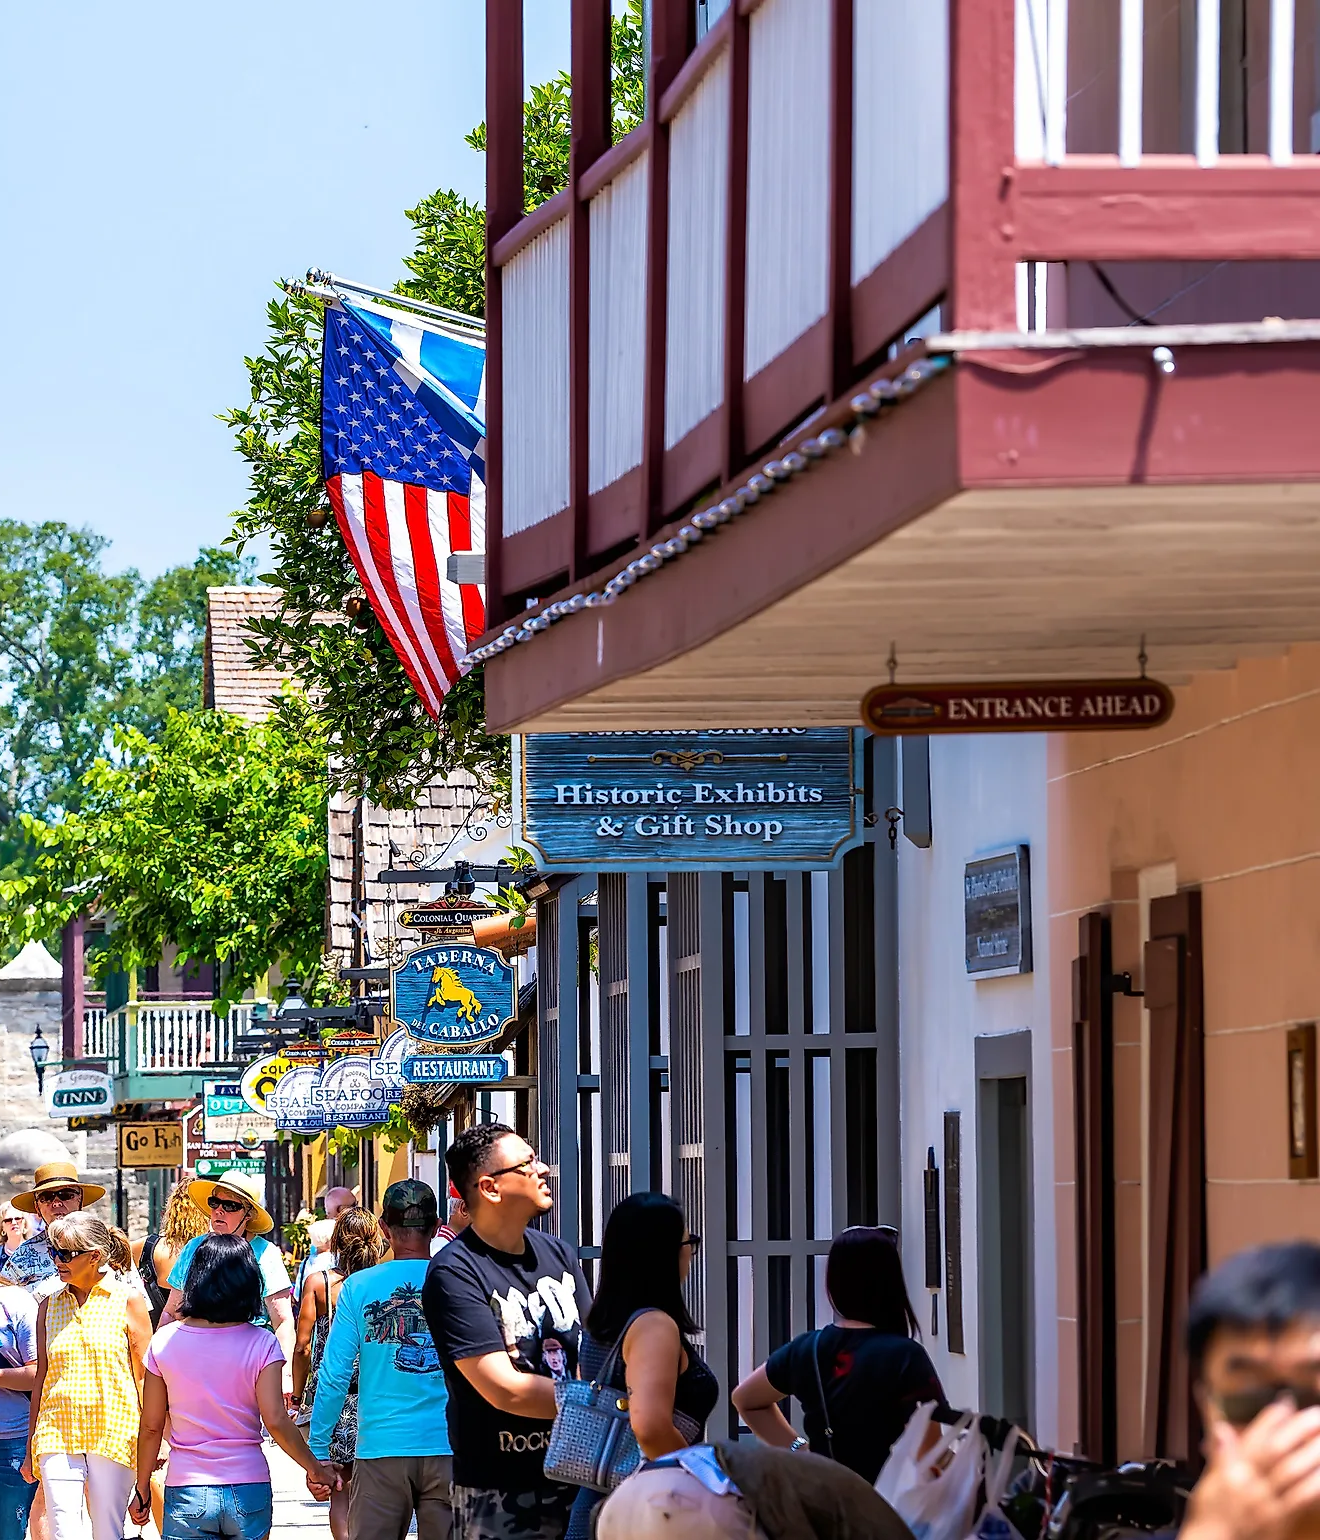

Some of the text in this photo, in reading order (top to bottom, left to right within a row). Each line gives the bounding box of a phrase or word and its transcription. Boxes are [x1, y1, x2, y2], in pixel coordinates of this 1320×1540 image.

[948, 695, 1161, 719] ENTRANCE AHEAD
[553, 782, 824, 805] Historic Exhibits
[595, 815, 784, 842] & Gift Shop
[411, 950, 498, 975] TABERNA
[411, 1013, 500, 1038] DEL CABALLO
[413, 1060, 496, 1077] RESTAURANT
[63, 1091, 97, 1104] INN
[315, 1089, 384, 1101] SEAFOO
[336, 1102, 376, 1110] COMPANY
[326, 1112, 387, 1121] RESTAURANT
[126, 1131, 148, 1150] Go
